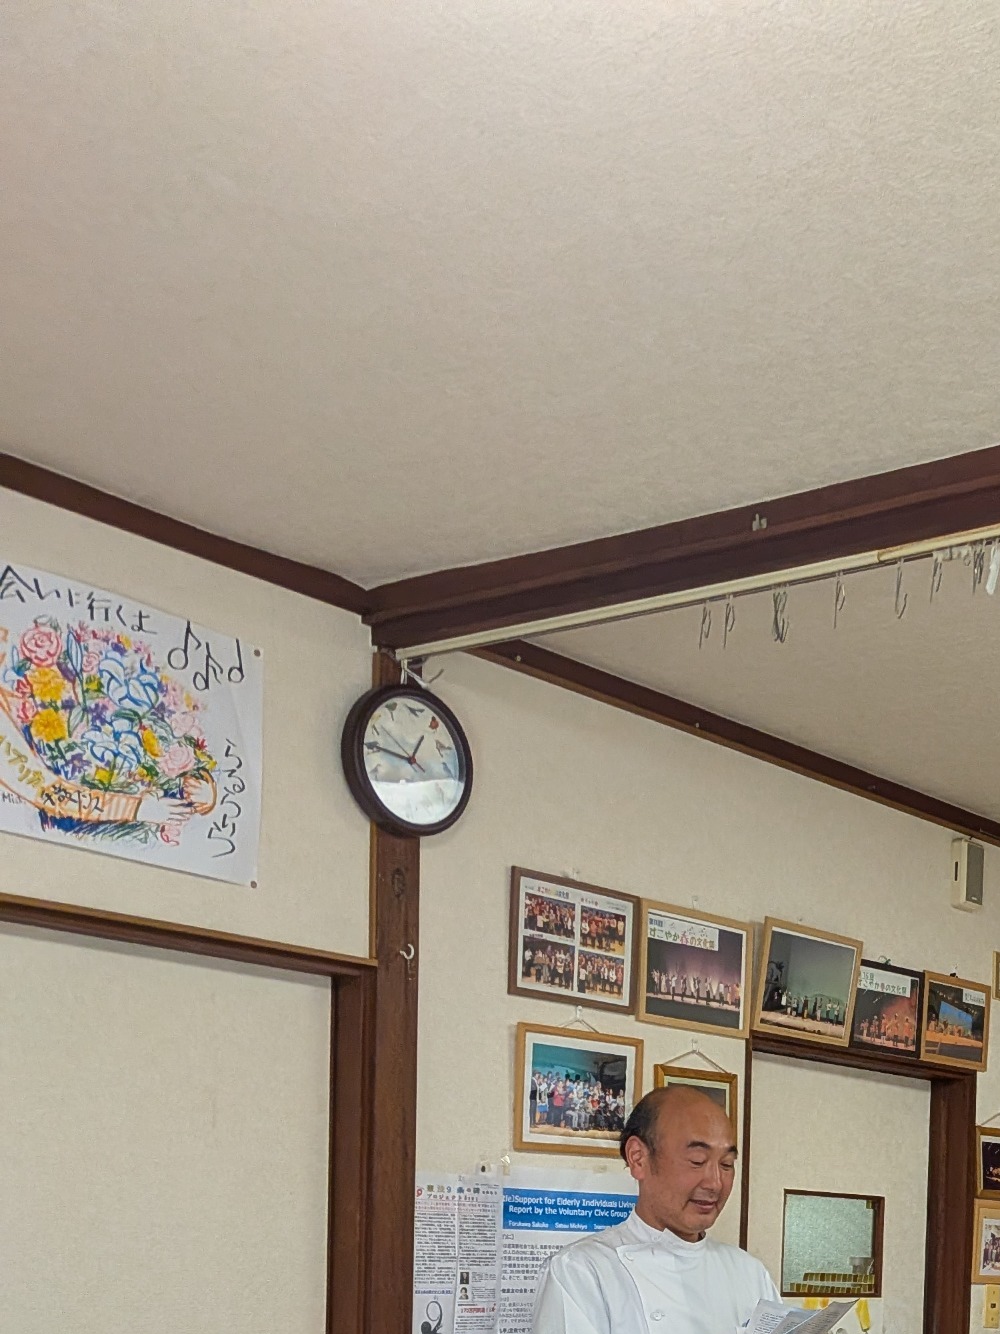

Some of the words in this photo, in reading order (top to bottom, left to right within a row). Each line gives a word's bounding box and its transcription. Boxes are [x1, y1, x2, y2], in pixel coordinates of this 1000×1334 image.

[545, 1197, 556, 1205] for
[557, 1198, 580, 1208] Elderly
[582, 1199, 618, 1208] Individuals
[508, 1206, 533, 1215] Report
[534, 1207, 543, 1216] by
[545, 1207, 557, 1215] the
[557, 1208, 593, 1218] Voluntary
[594, 1209, 609, 1217] Civic
[610, 1210, 628, 1218] Group
